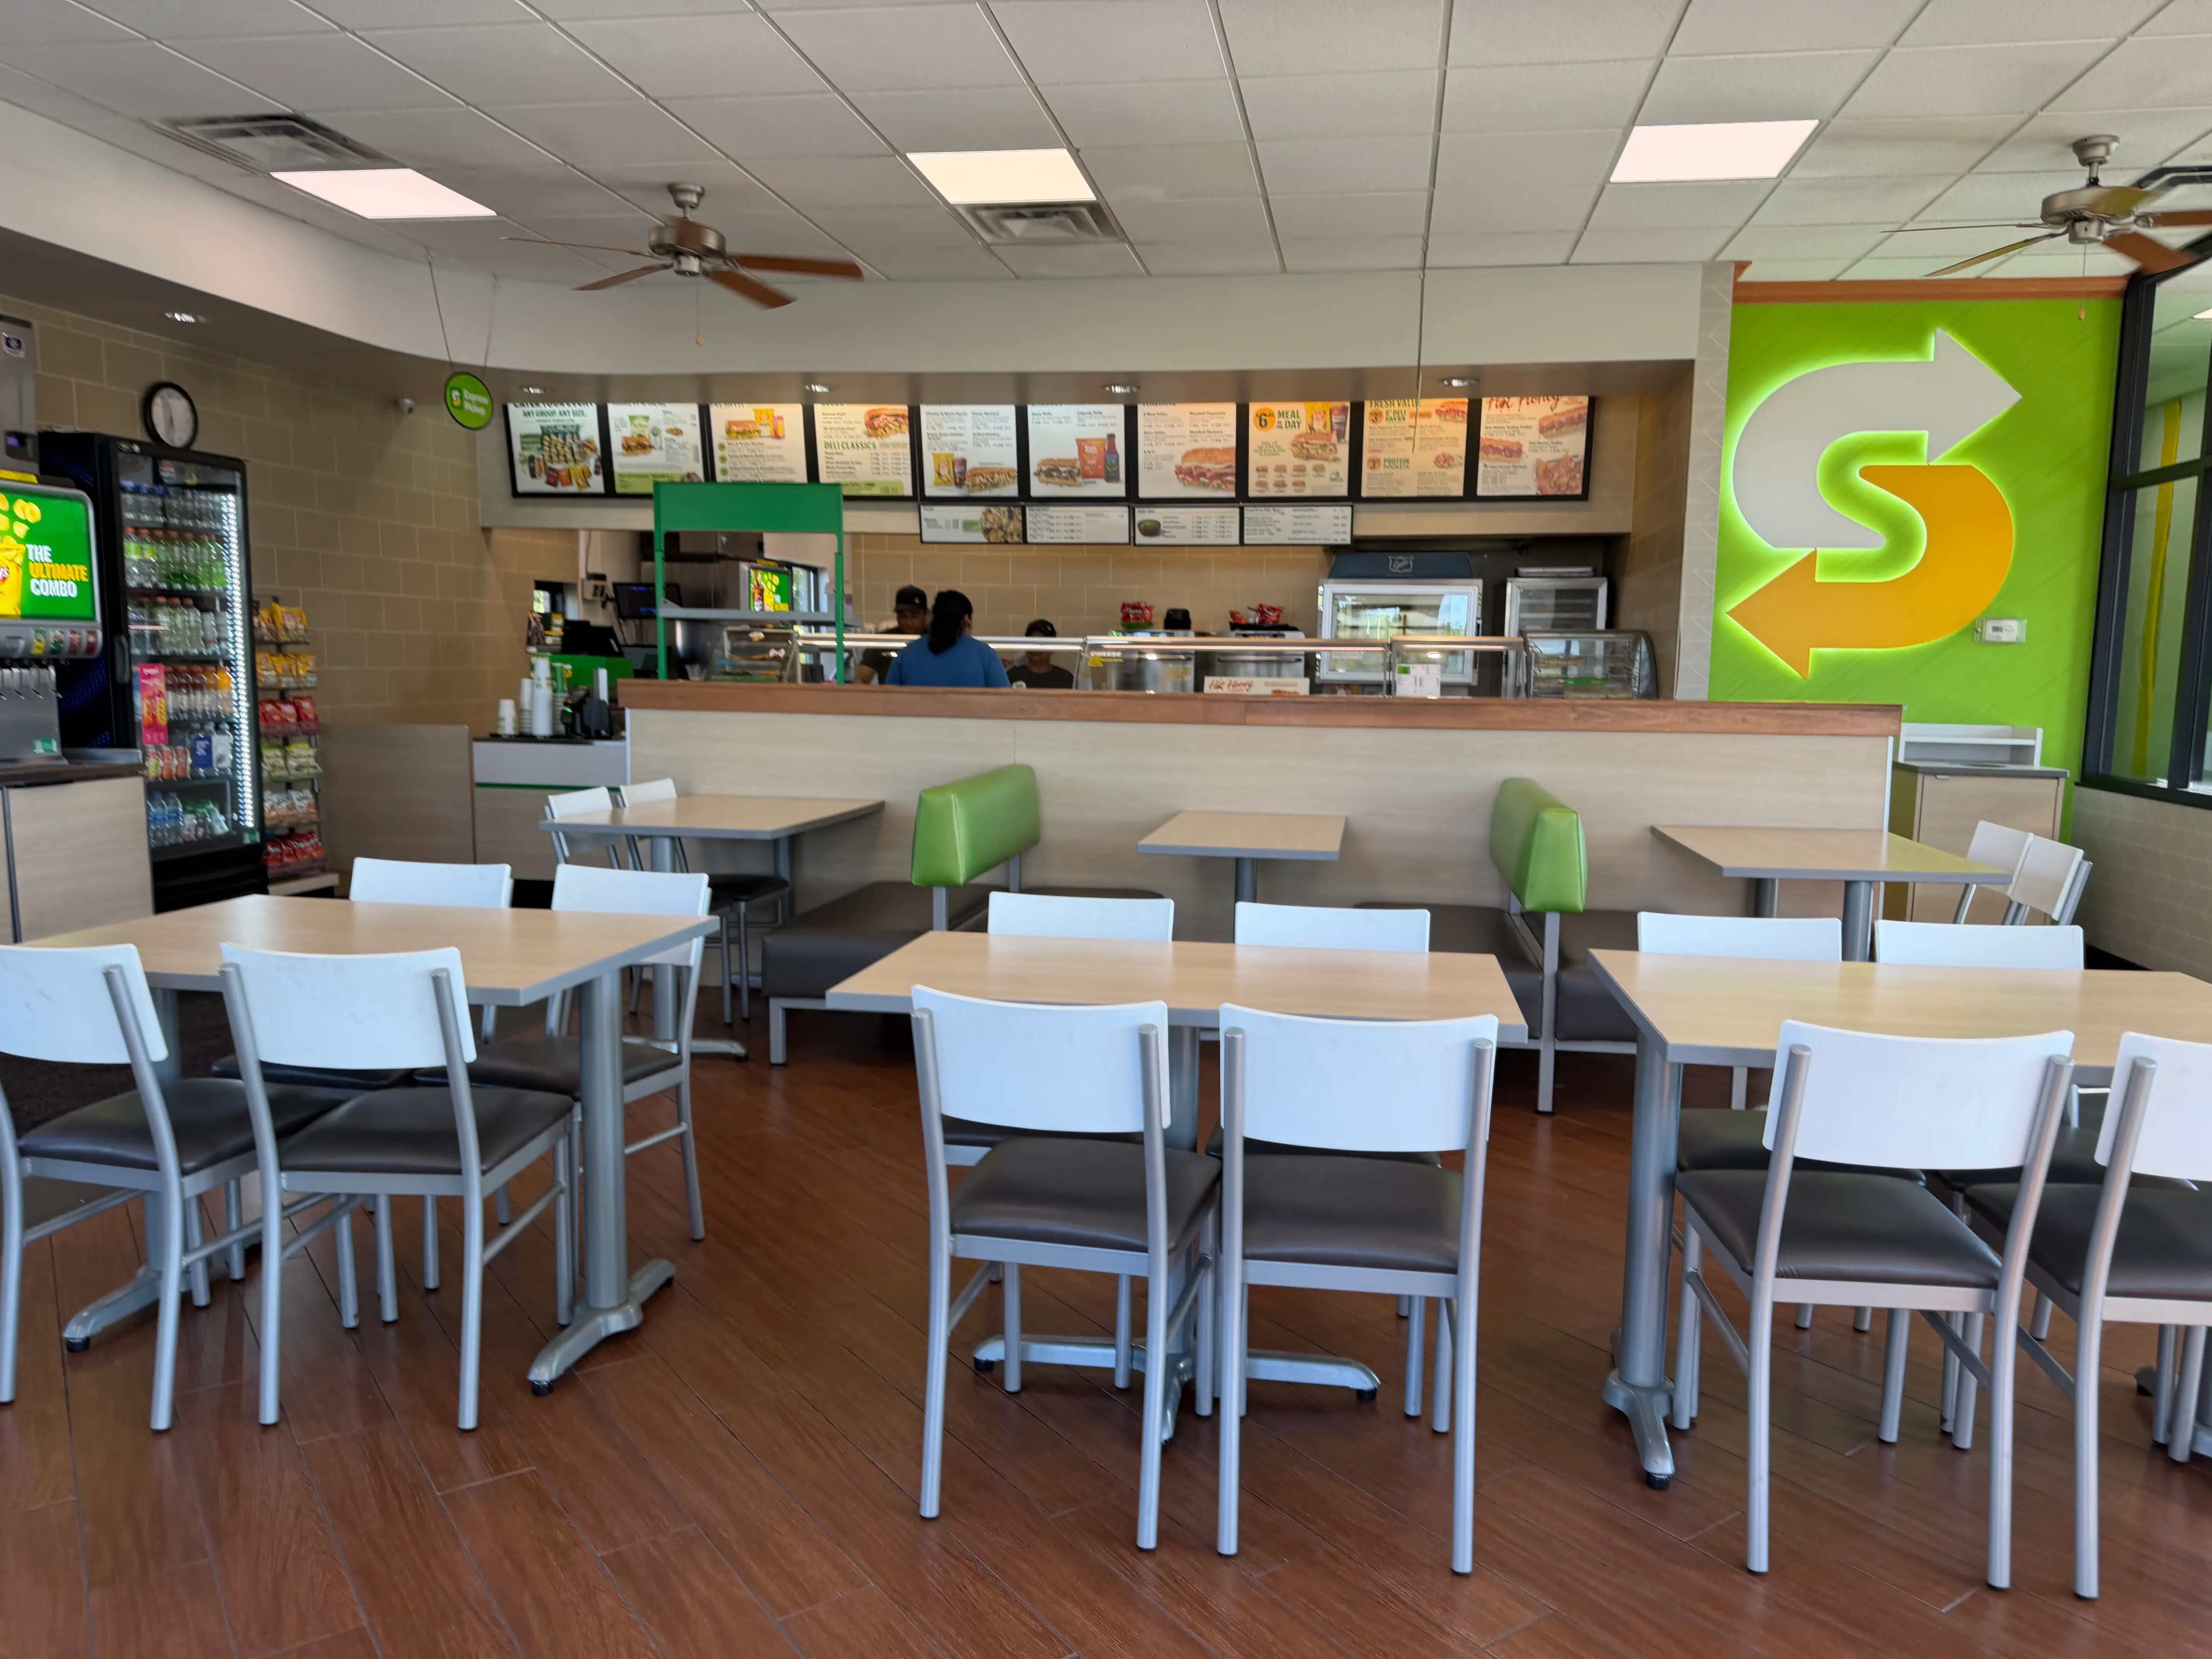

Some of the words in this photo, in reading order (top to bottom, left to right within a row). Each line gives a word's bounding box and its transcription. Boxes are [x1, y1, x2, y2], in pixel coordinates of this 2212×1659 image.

[1278, 410, 1300, 419] MEAL
[1285, 420, 1301, 429] DAY
[824, 441, 840, 450] DELI
[841, 441, 877, 450] CLASSICS
[26, 544, 52, 563] THE
[29, 561, 89, 582] ULTIMATE
[30, 578, 77, 598] COMBO
